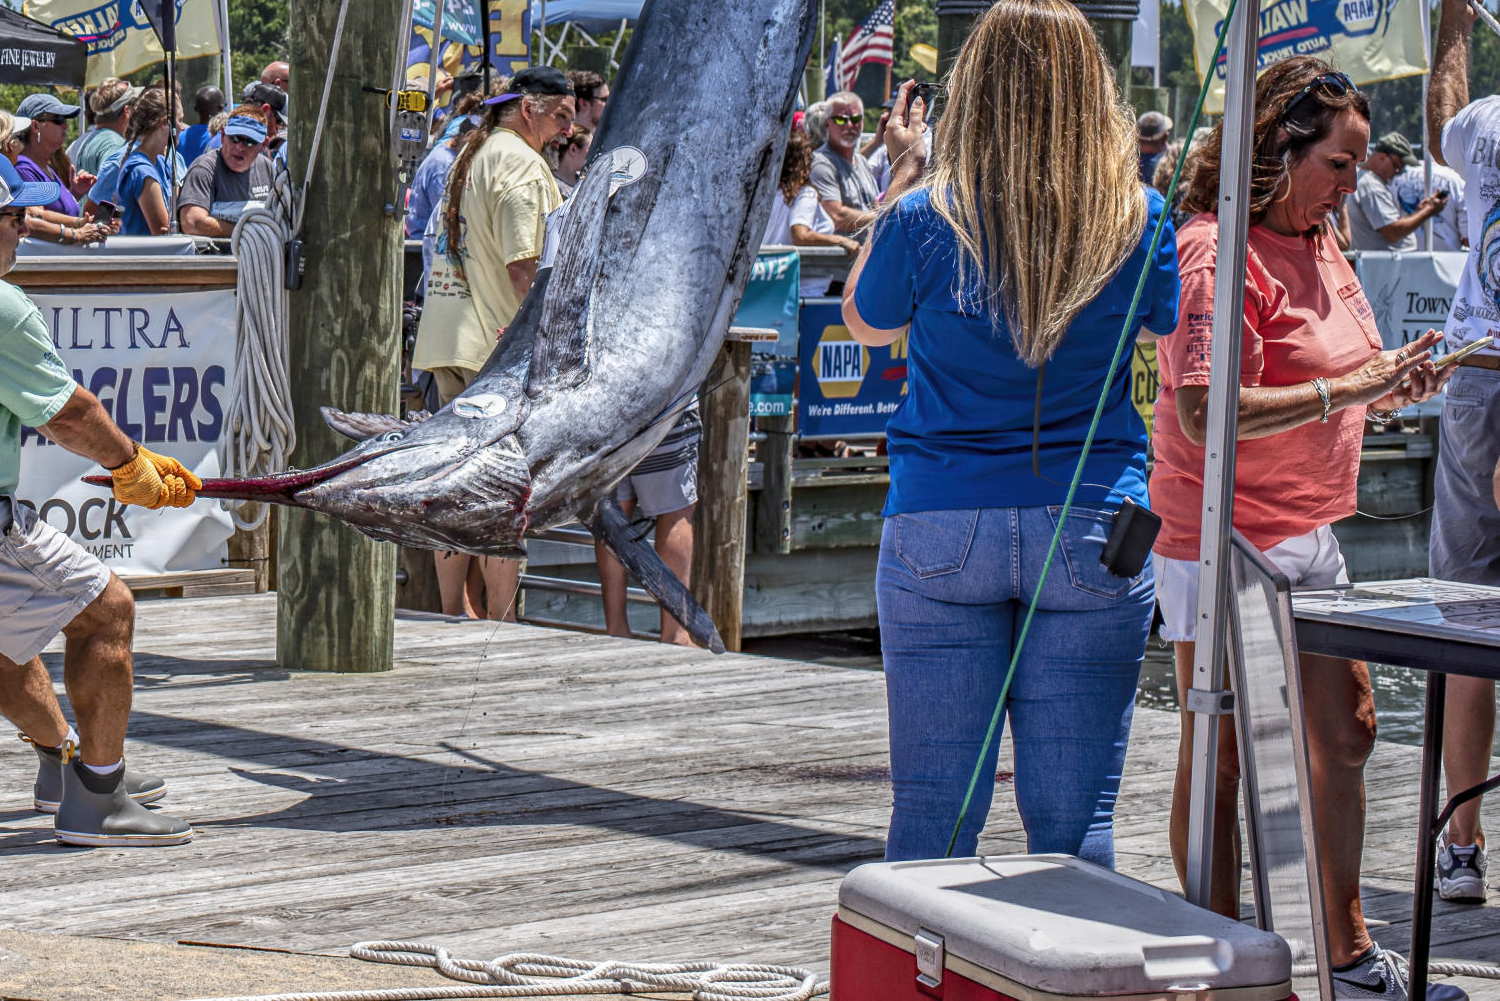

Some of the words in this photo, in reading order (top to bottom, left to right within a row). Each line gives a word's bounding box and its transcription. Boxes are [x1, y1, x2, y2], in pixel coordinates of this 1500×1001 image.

[0, 48, 21, 66] FINE
[21, 49, 56, 71] JEWELRY
[752, 256, 791, 281] ATE
[1186, 344, 1212, 353] ULTR
[822, 344, 862, 378] NAPA
[20, 364, 226, 447] GLERS
[749, 400, 785, 414] e.com
[808, 404, 832, 417] We're
[834, 403, 875, 416] Different.
